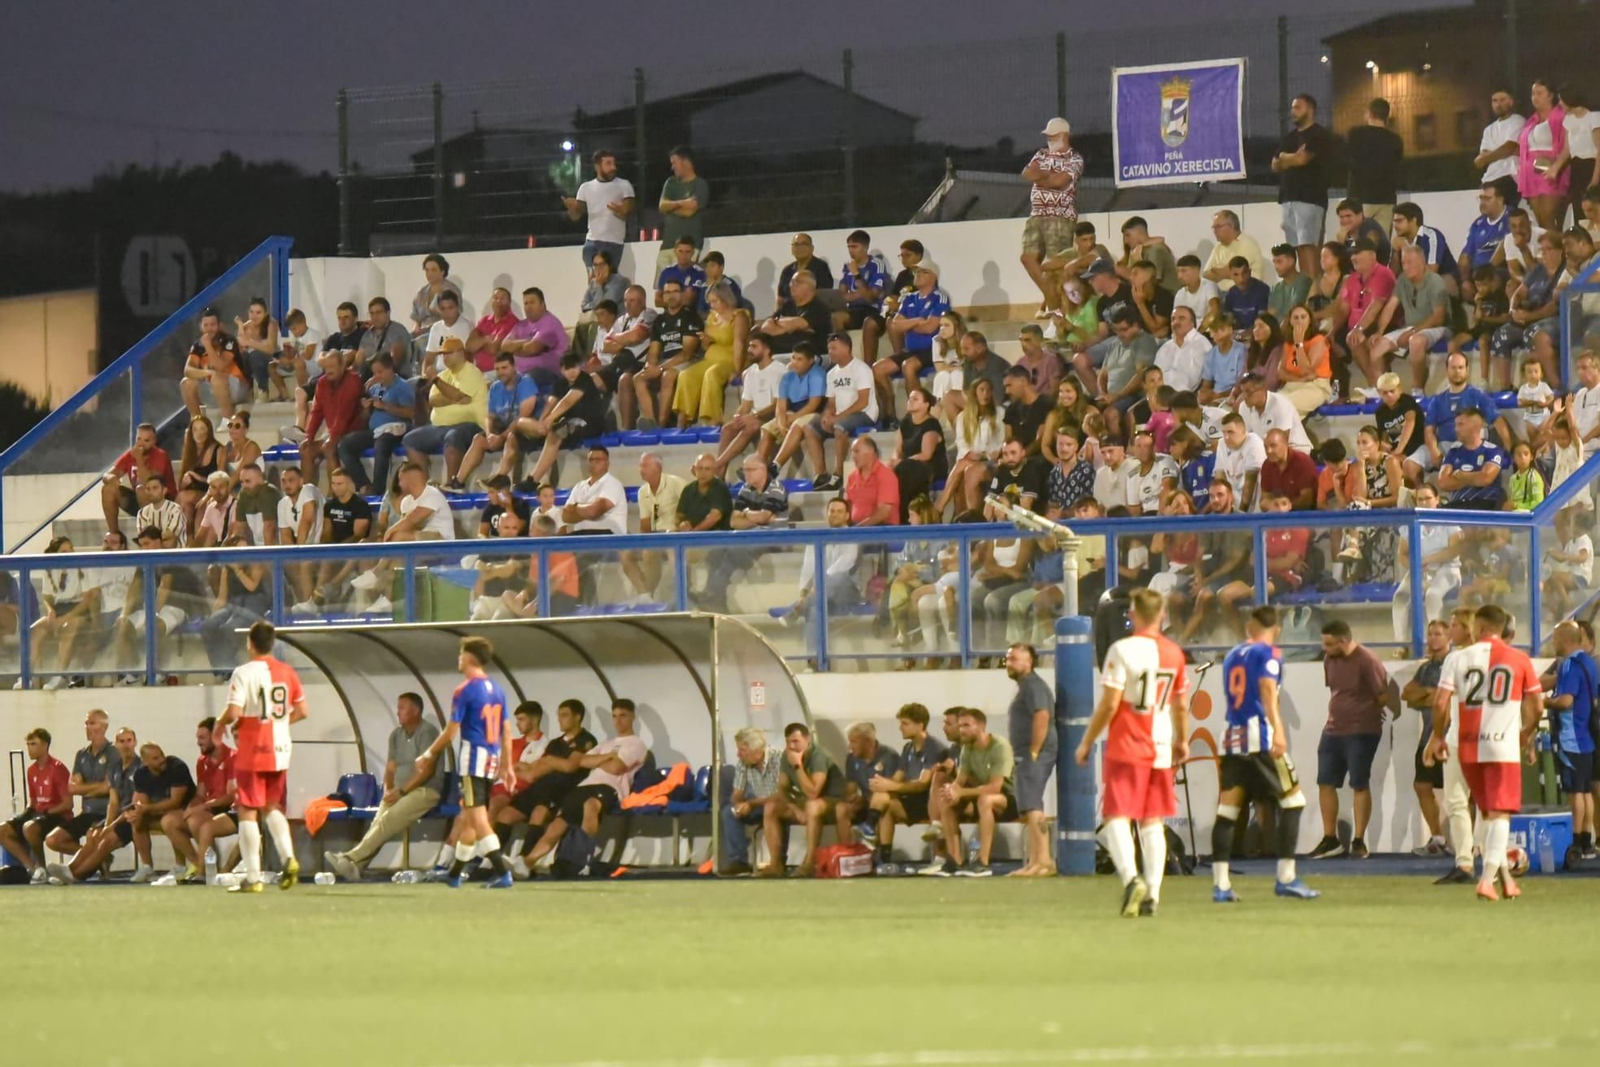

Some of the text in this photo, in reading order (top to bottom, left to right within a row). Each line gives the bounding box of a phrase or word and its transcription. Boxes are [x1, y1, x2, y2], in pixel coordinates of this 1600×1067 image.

[1122, 158, 1234, 178] CATAVINO XERECISTA
[1164, 151, 1184, 161] PEÑA
[258, 684, 287, 720] 19
[1134, 670, 1175, 712] 17
[1229, 666, 1247, 709] 9
[1465, 665, 1512, 709] 20
[481, 703, 502, 744] 11
[1164, 816, 1197, 827] DEPORE
